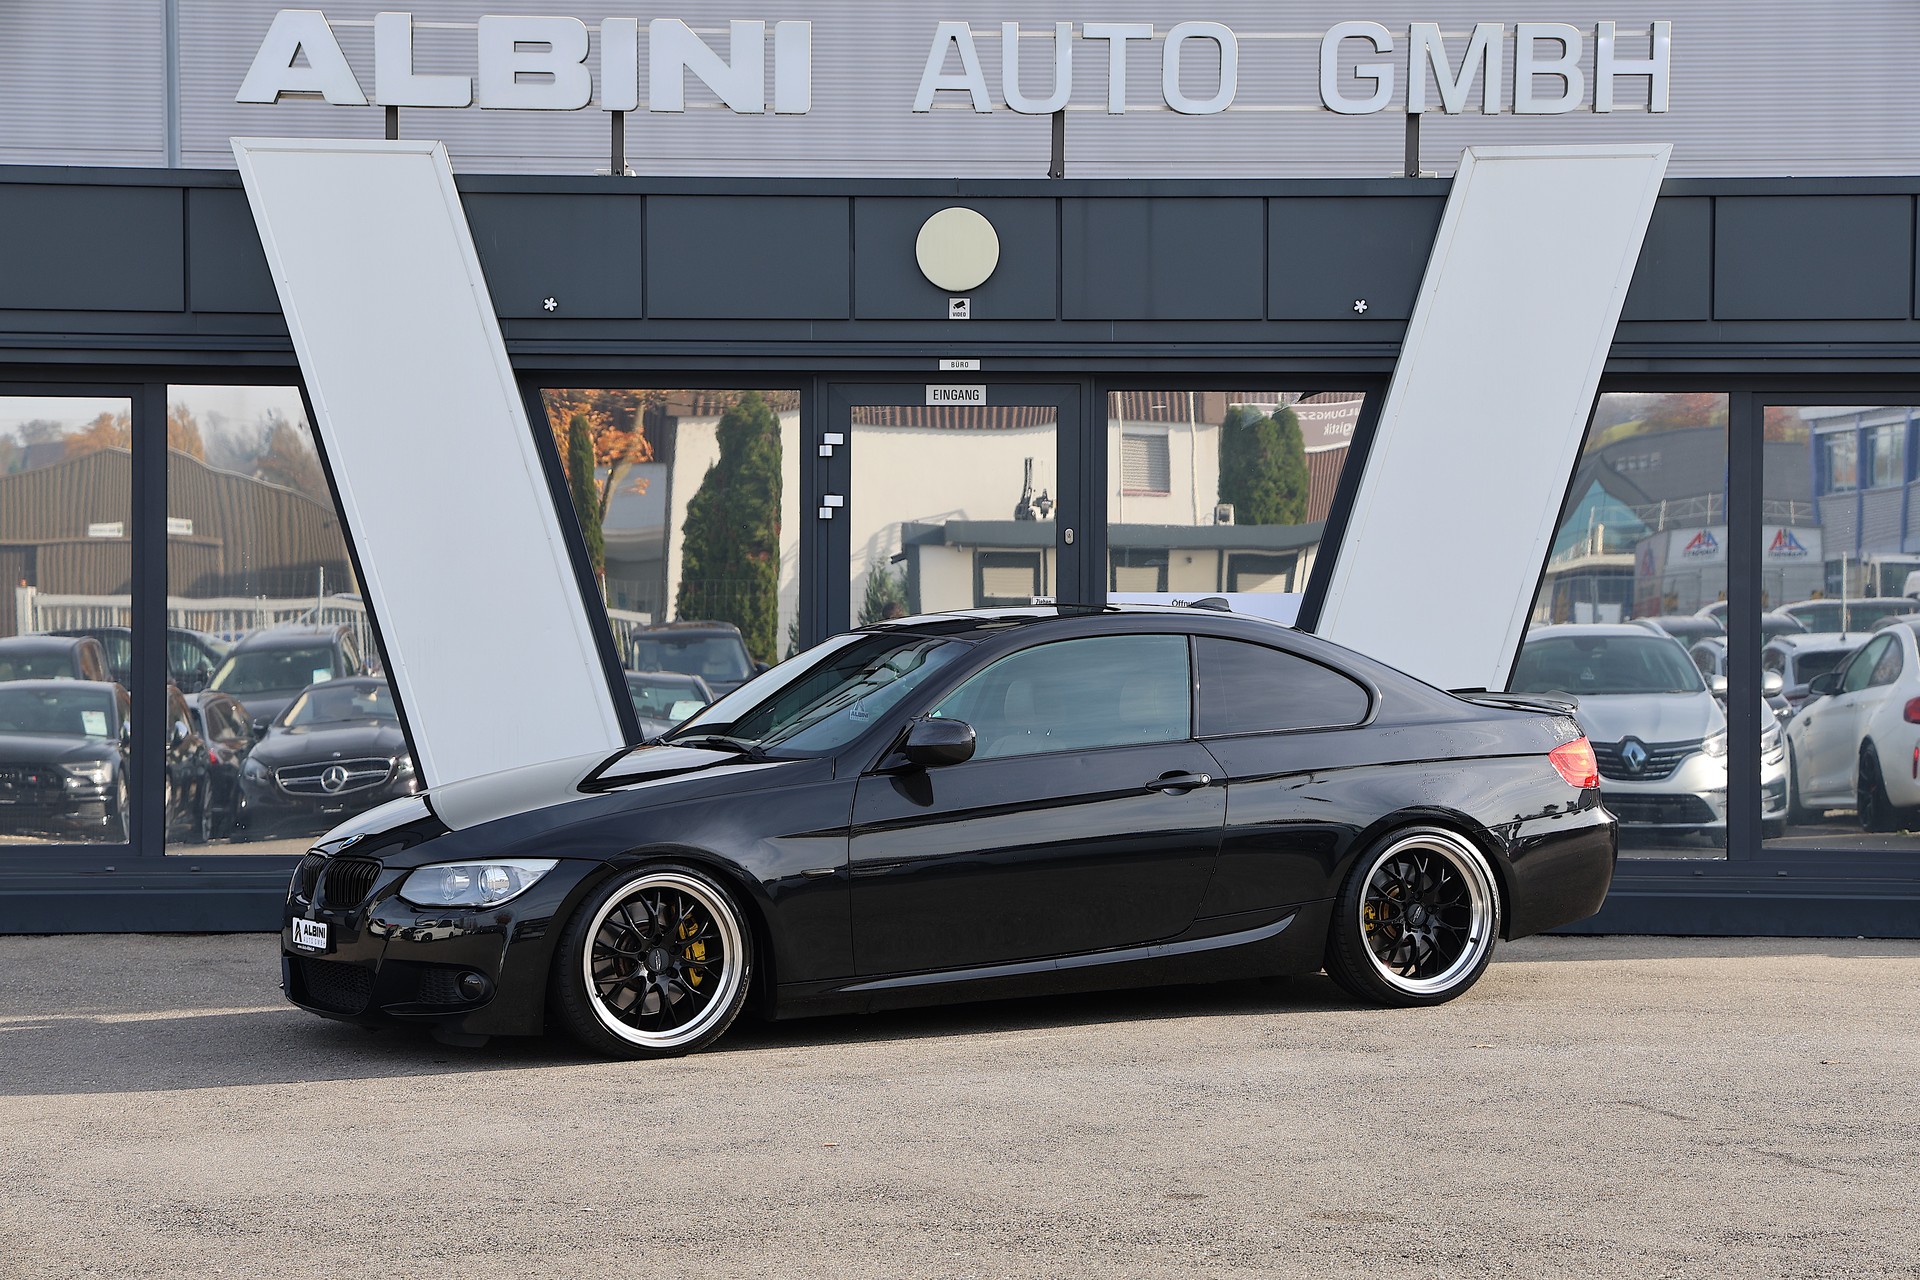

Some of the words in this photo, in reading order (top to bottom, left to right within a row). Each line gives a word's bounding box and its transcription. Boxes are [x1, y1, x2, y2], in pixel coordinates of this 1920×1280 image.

[235, 8, 812, 115] ALBINI
[911, 20, 1238, 116] AUTO
[1318, 20, 1672, 116] GMBH
[933, 389, 980, 401] EINGANG
[303, 924, 326, 939] ALBINI
